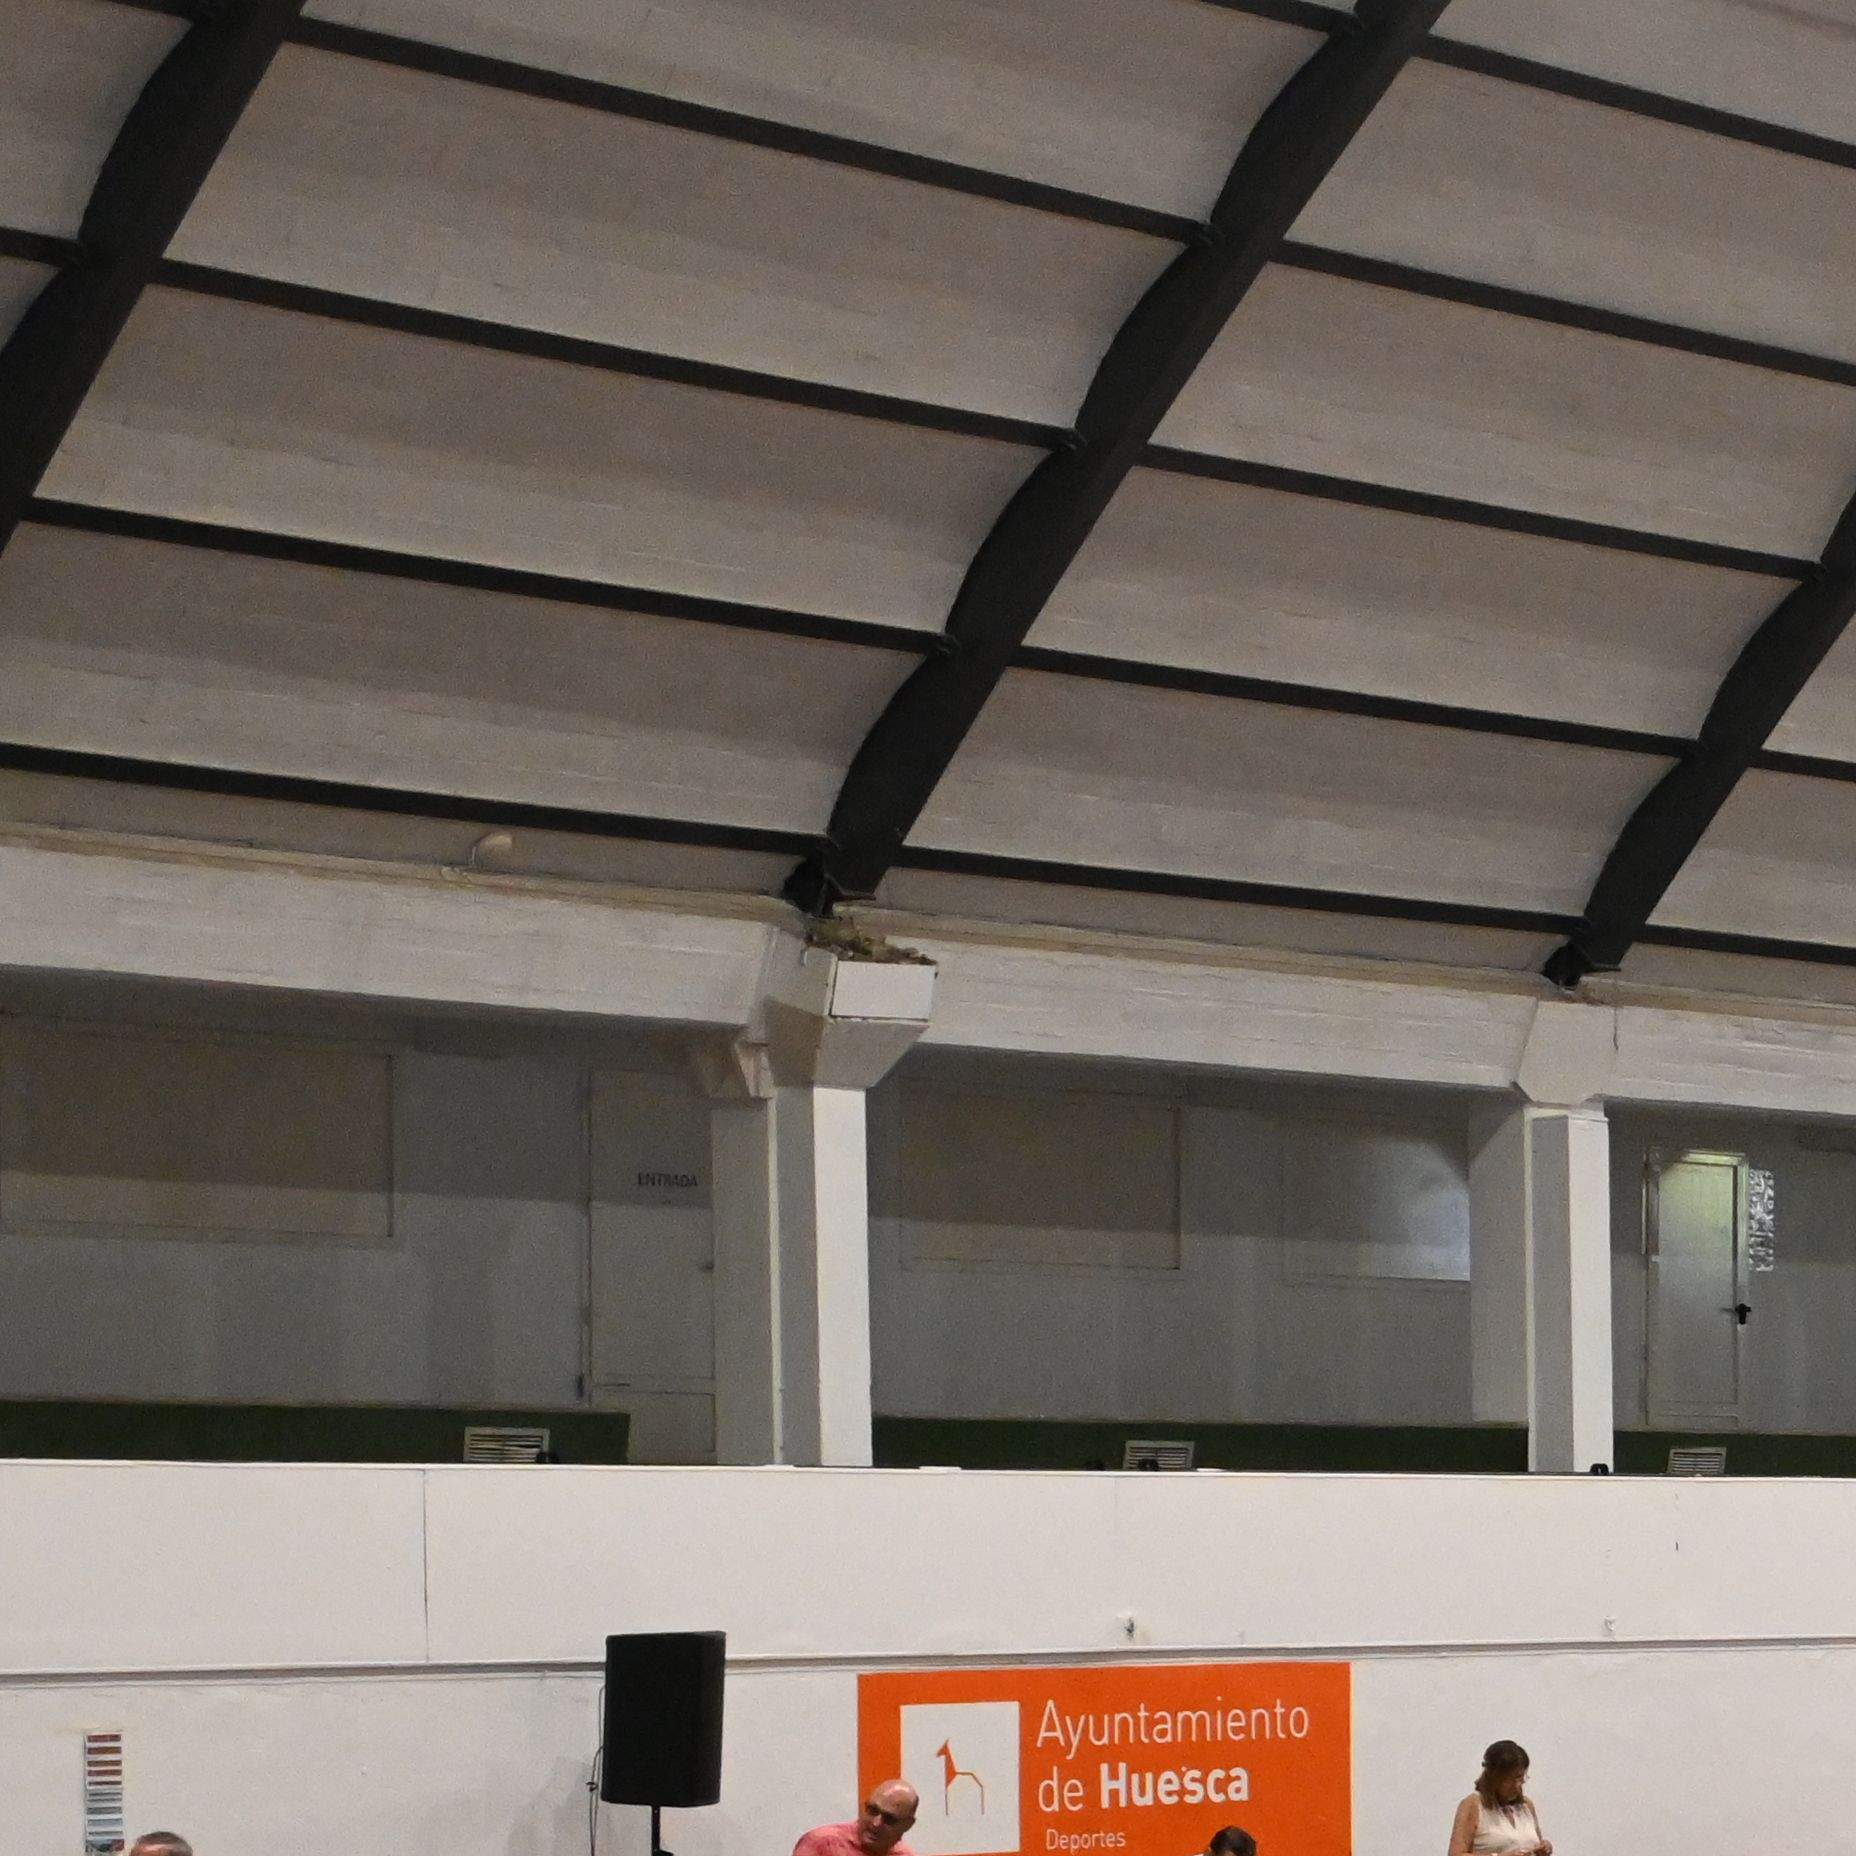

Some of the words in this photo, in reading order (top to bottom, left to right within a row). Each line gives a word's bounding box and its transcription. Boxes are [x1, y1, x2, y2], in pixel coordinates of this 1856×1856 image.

[638, 1172, 698, 1187] ENTRADA
[1036, 1695, 1310, 1760] Ayuntamiento
[1038, 1765, 1085, 1814] de
[1099, 1762, 1250, 1810] Huesca
[1046, 1827, 1126, 1856] Deportes
